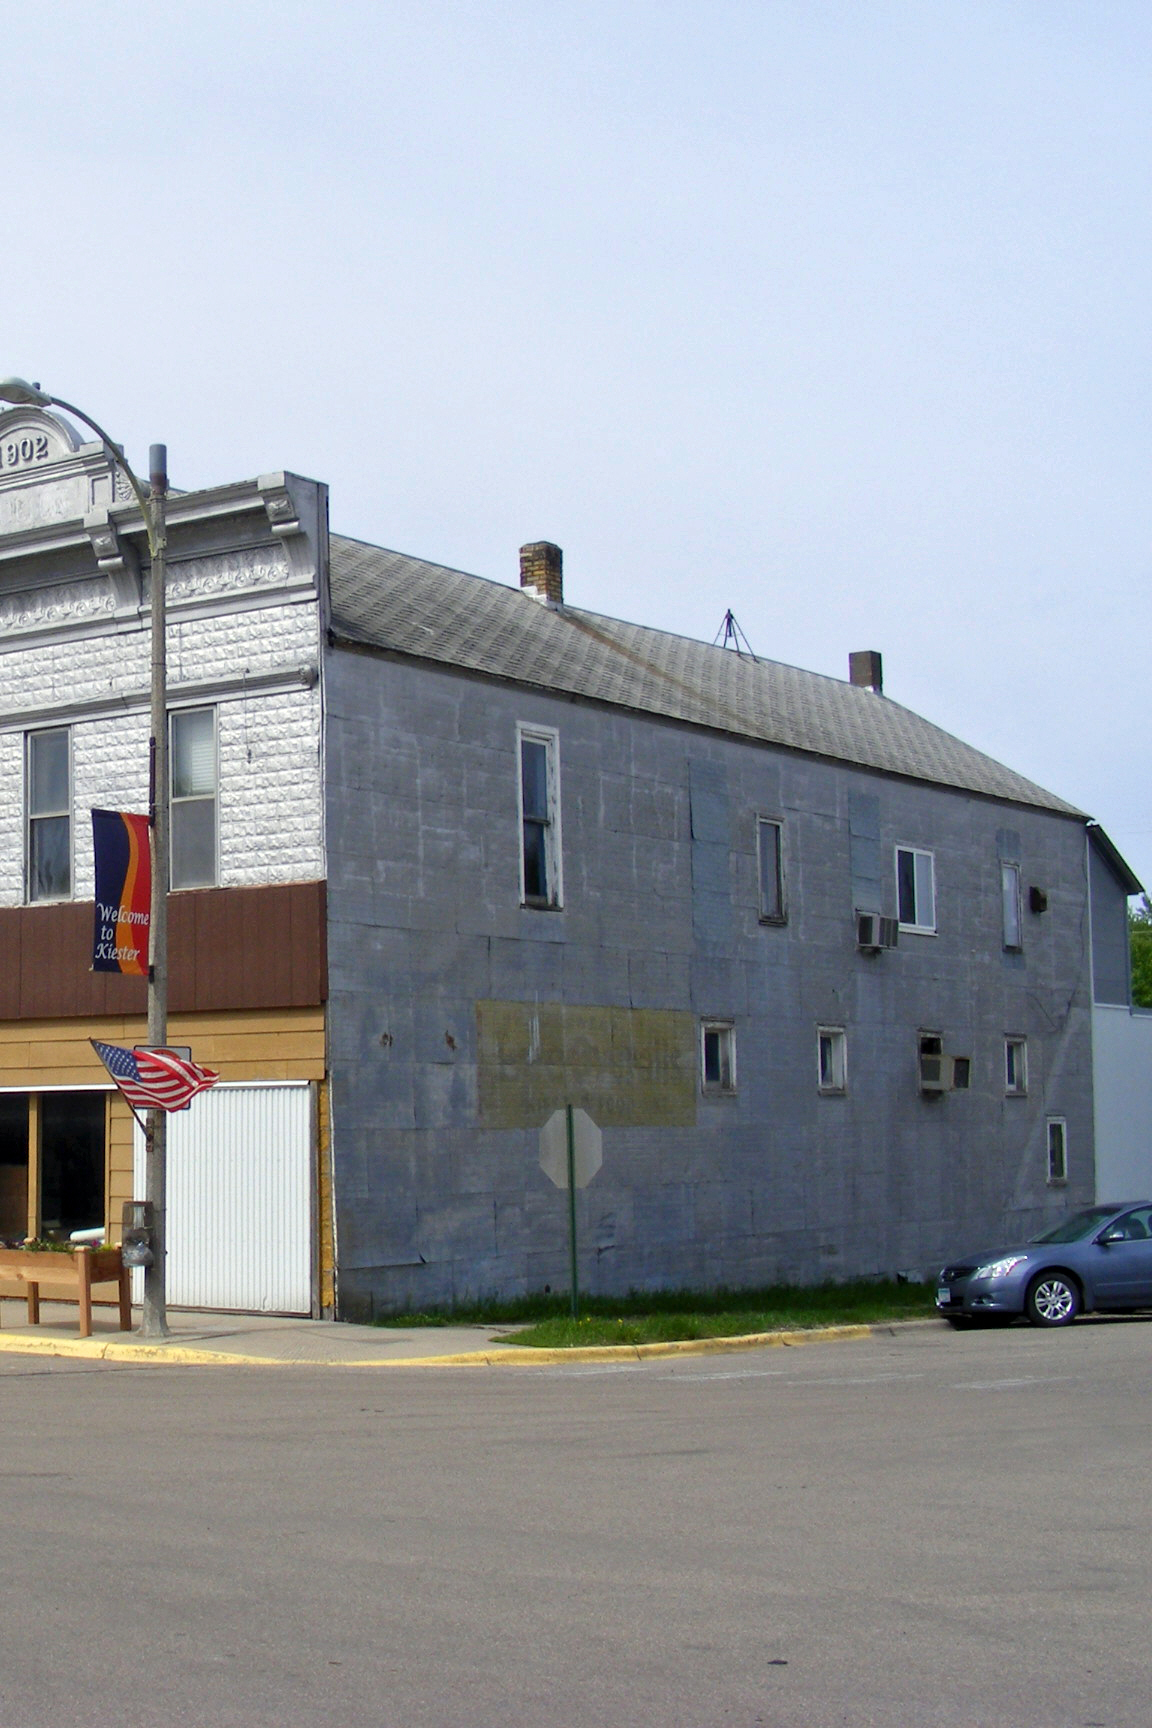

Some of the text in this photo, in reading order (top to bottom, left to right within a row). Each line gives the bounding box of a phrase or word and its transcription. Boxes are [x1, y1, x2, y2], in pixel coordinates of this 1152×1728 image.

[97, 903, 150, 925] Welcome
[101, 925, 114, 940] to
[95, 943, 140, 961] Kiester
